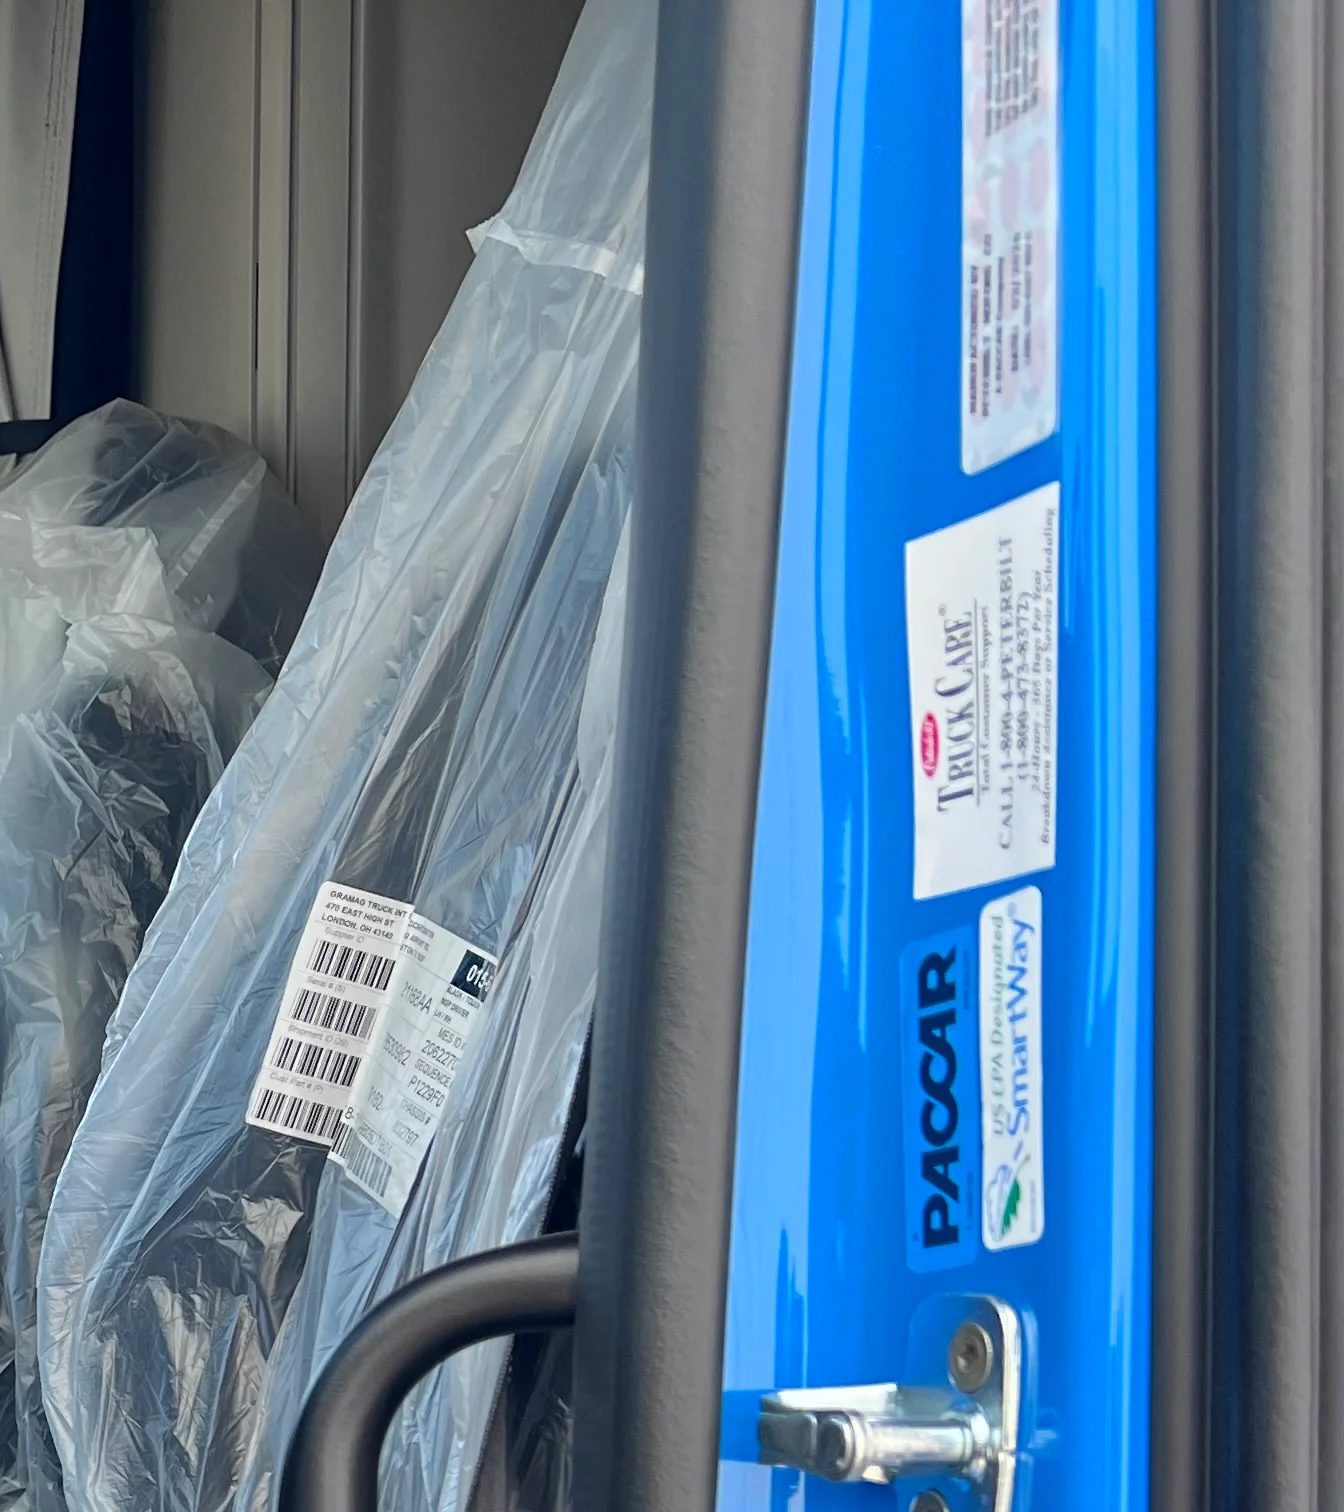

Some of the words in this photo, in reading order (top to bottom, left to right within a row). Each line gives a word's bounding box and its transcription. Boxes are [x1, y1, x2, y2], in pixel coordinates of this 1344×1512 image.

[998, 776, 1014, 851] CALL
[325, 902, 341, 912] 470
[341, 906, 364, 918] EAST
[363, 912, 384, 924] HIGH
[383, 919, 395, 928] ST
[367, 900, 394, 915] TRUCK
[359, 924, 373, 934] OH
[989, 914, 1012, 1046] Designated
[915, 943, 960, 1249] PACCAR
[990, 1103, 1005, 1138] US
